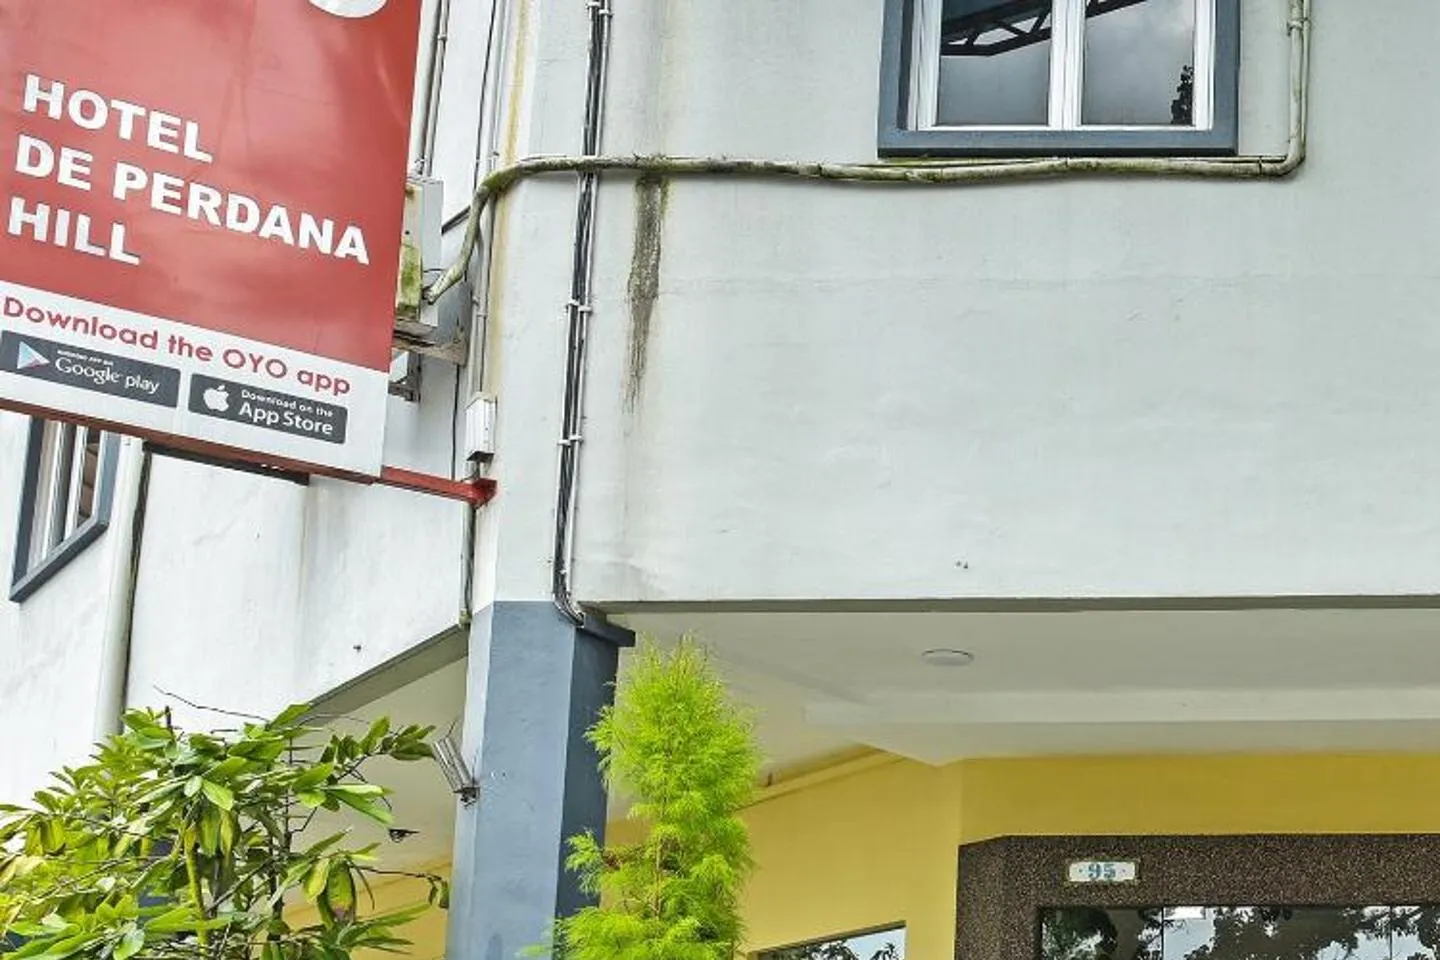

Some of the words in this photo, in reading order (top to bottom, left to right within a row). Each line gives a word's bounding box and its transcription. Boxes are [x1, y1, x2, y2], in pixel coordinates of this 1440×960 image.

[23, 74, 213, 163] HOTEL
[15, 135, 93, 191] DE
[112, 161, 369, 265] PERDANA
[8, 197, 140, 266] HILL
[3, 296, 158, 350] Download
[168, 334, 213, 362] the
[222, 349, 288, 379] OYO
[297, 369, 351, 396] app
[55, 356, 121, 385] Google
[125, 374, 160, 394] play
[238, 401, 279, 426] App
[283, 411, 333, 435] Store
[241, 388, 296, 410] Download
[299, 404, 313, 413] on
[316, 405, 333, 418] the
[1088, 863, 1117, 880] 95
